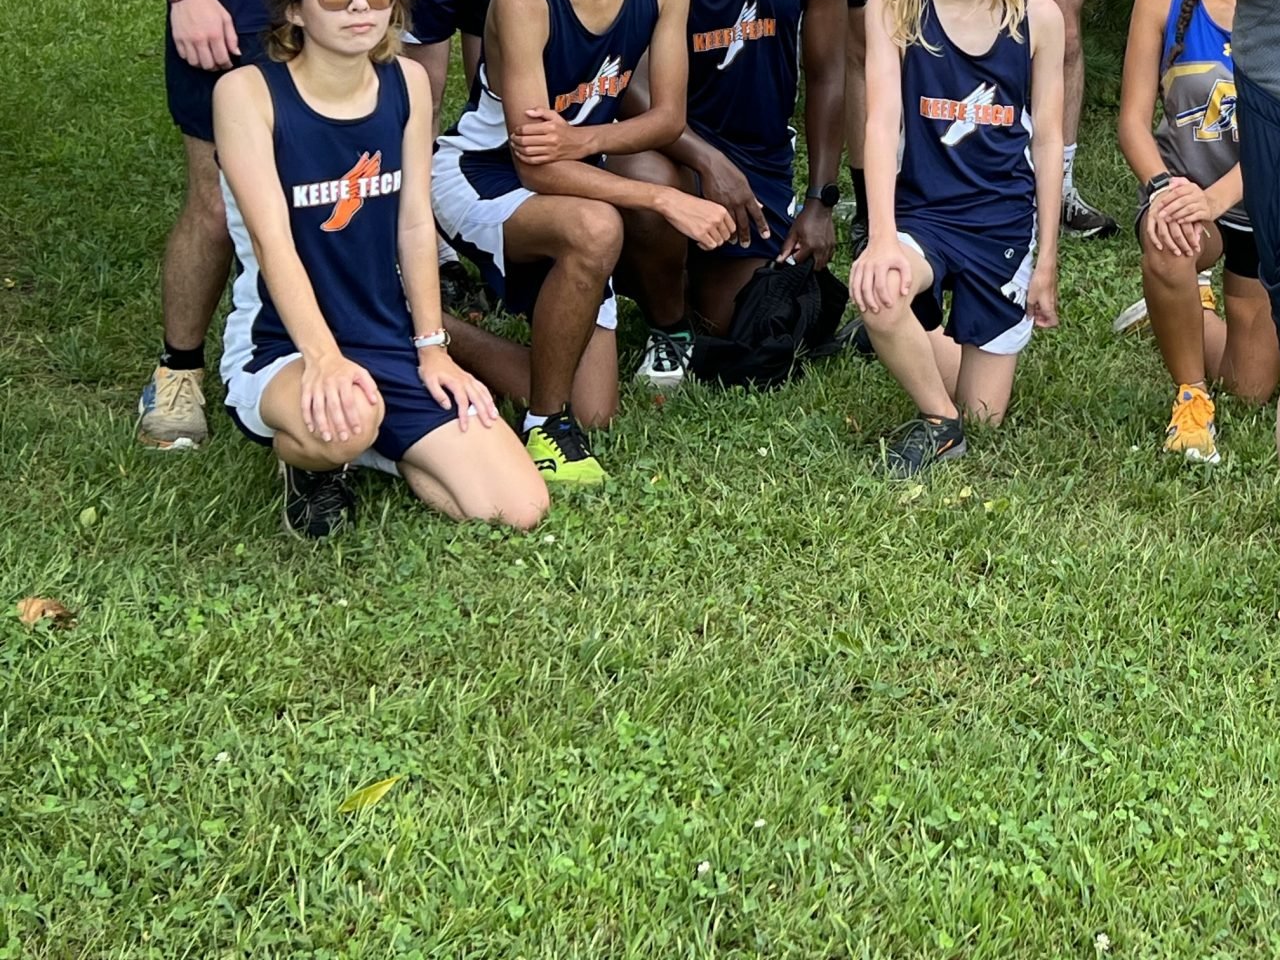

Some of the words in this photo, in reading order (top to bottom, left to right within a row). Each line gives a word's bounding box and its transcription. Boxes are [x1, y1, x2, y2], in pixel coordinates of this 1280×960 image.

[920, 95, 968, 121] KEEFE
[974, 104, 1015, 126] TECH
[292, 179, 351, 208] KEEFE
